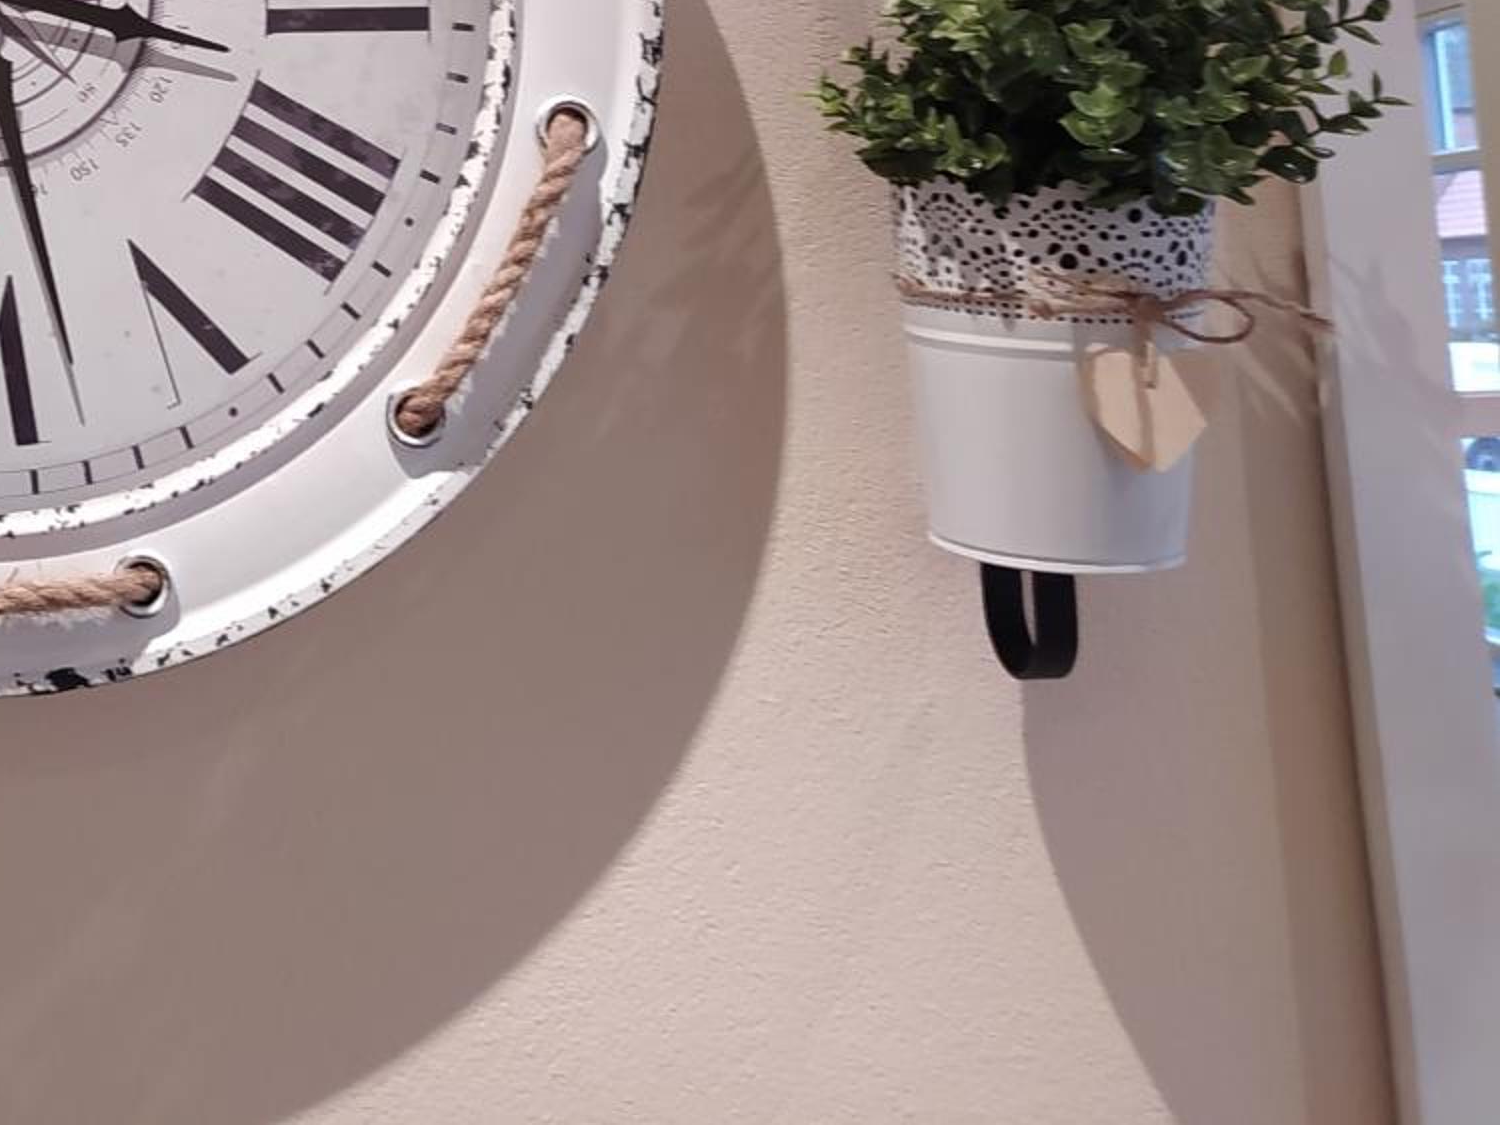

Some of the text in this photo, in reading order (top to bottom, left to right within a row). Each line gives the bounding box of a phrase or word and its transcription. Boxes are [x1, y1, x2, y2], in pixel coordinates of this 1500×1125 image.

[149, 75, 173, 105] 120
[114, 121, 143, 149] 135
[69, 157, 100, 183] 150
[180, 69, 405, 297] IIII
[127, 238, 262, 410] V
